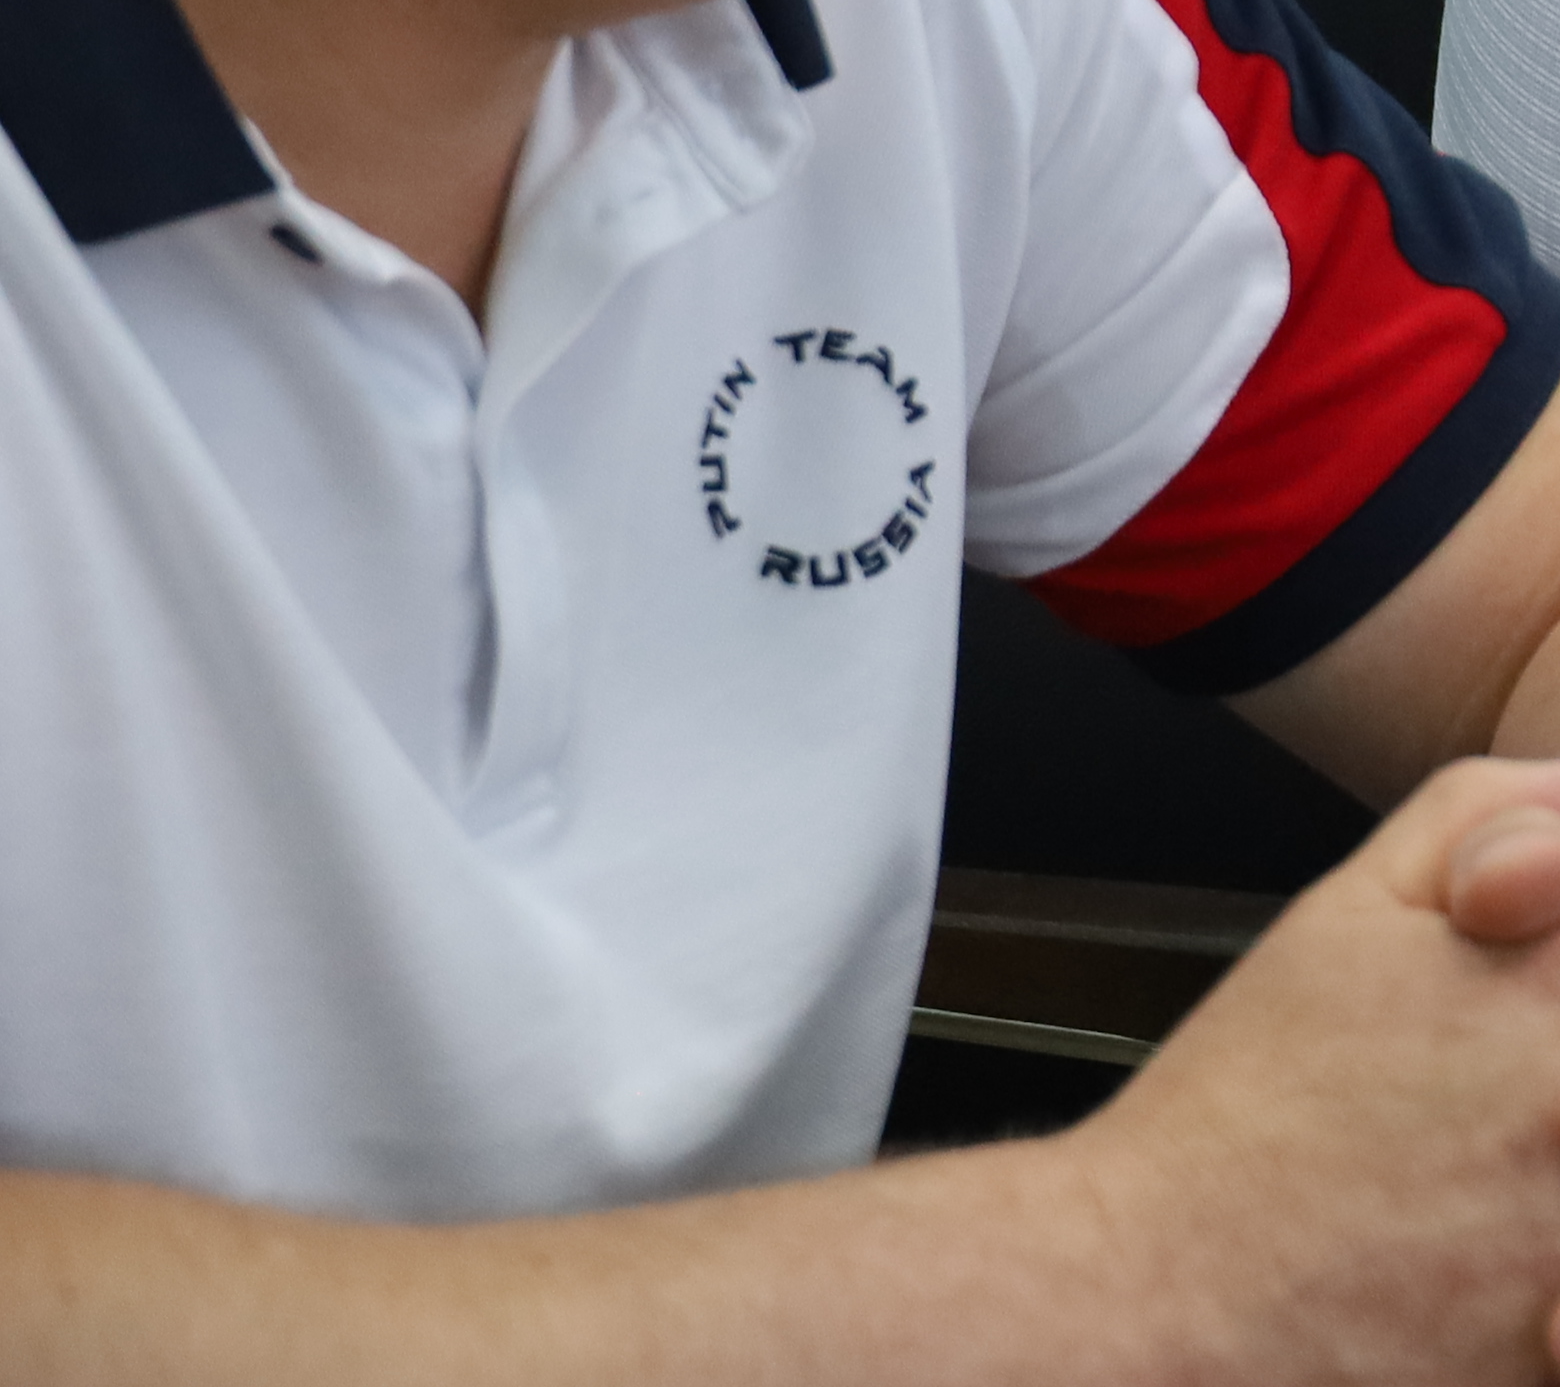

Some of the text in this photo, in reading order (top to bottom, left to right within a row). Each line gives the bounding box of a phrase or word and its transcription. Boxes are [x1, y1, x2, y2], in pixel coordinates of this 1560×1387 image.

[699, 327, 928, 539] PUTIN TEAM
[759, 458, 936, 588] RUSSIA
